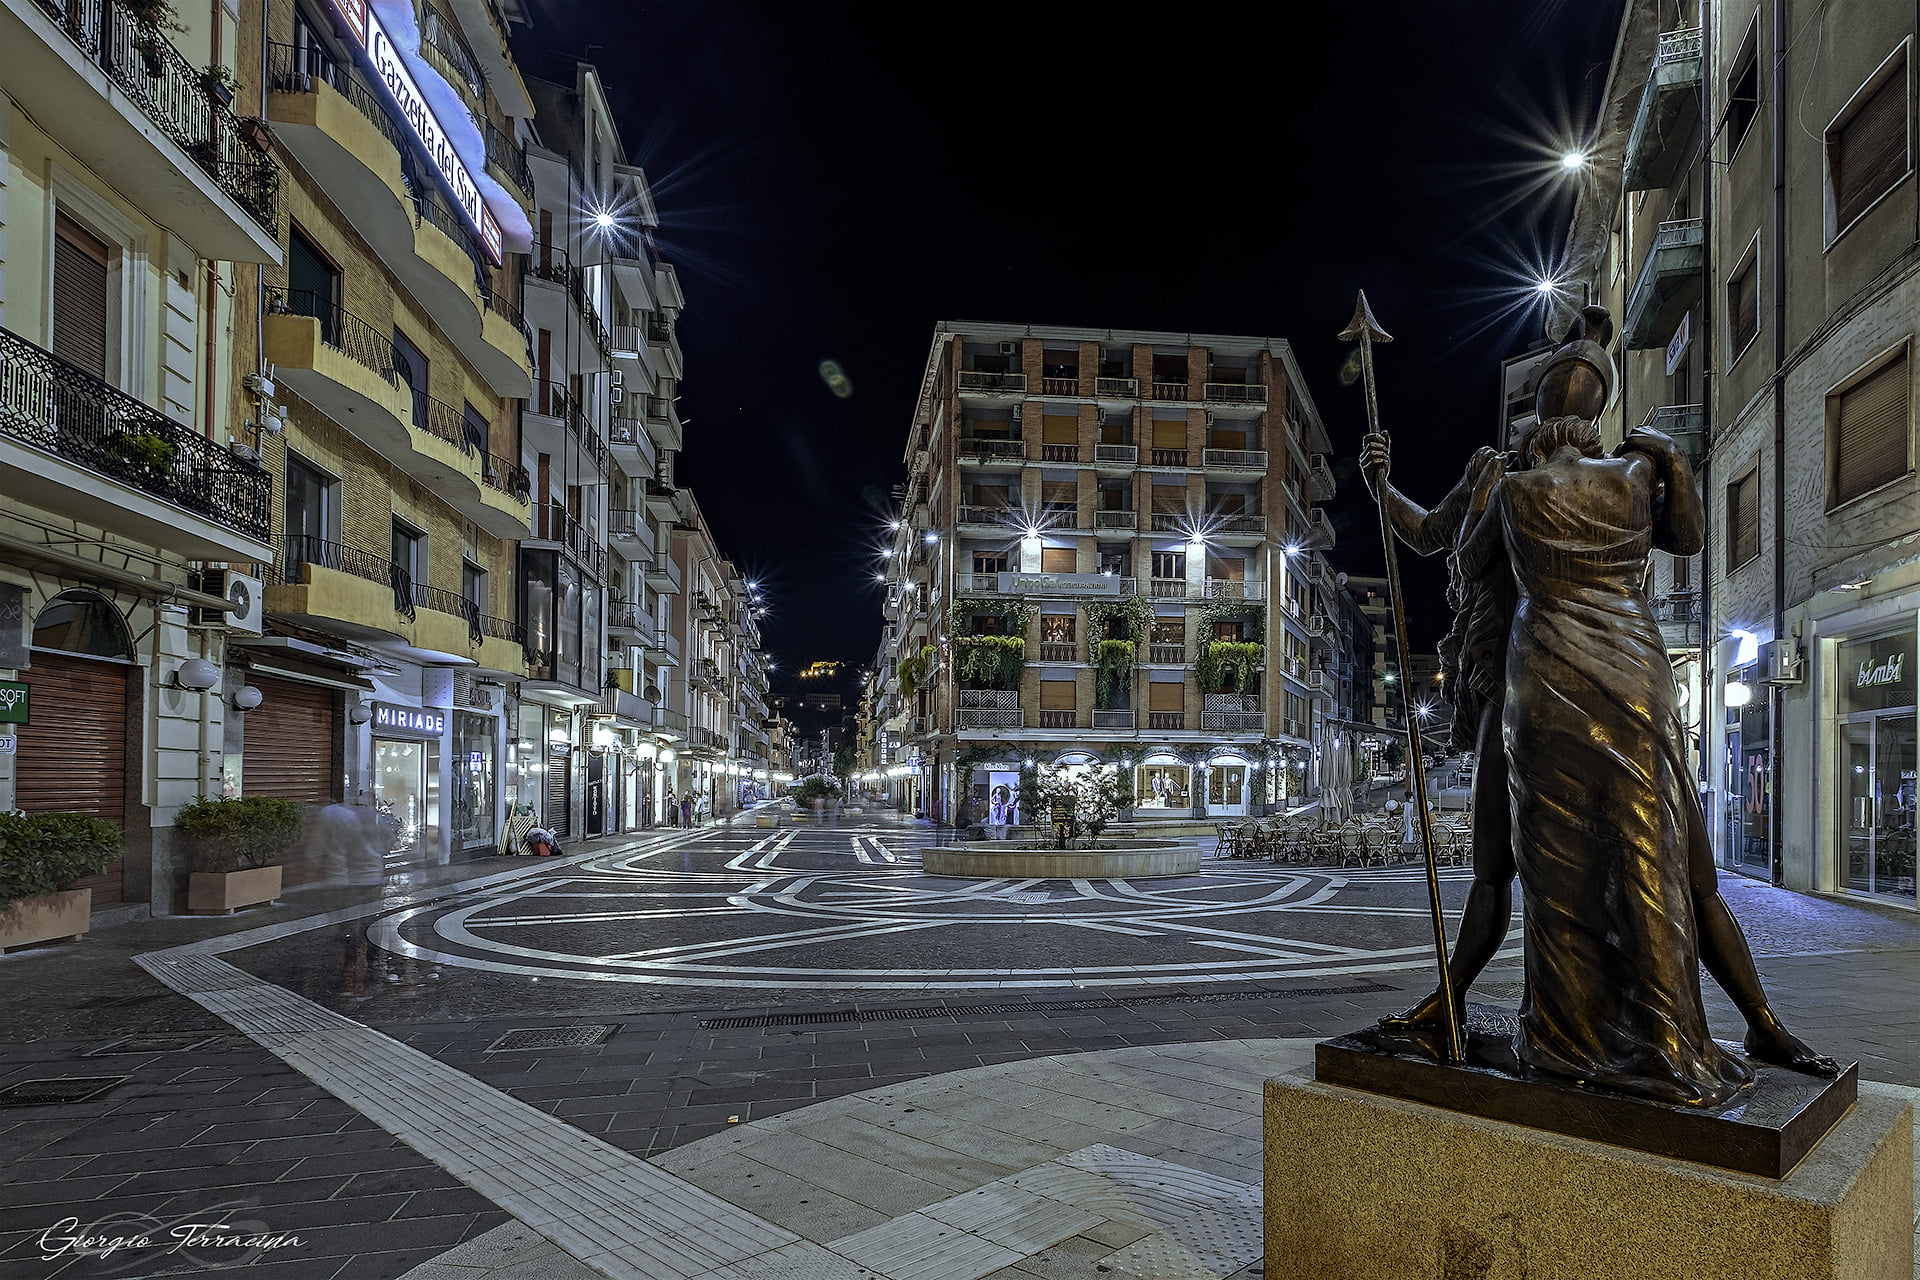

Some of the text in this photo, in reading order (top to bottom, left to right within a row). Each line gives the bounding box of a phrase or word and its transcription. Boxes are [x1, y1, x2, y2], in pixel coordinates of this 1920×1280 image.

[374, 31, 477, 224] Gazzetta del Sud
[1857, 653, 1904, 688] bimbi
[377, 707, 444, 732] MIRIADE
[1745, 753, 1764, 815] 50
